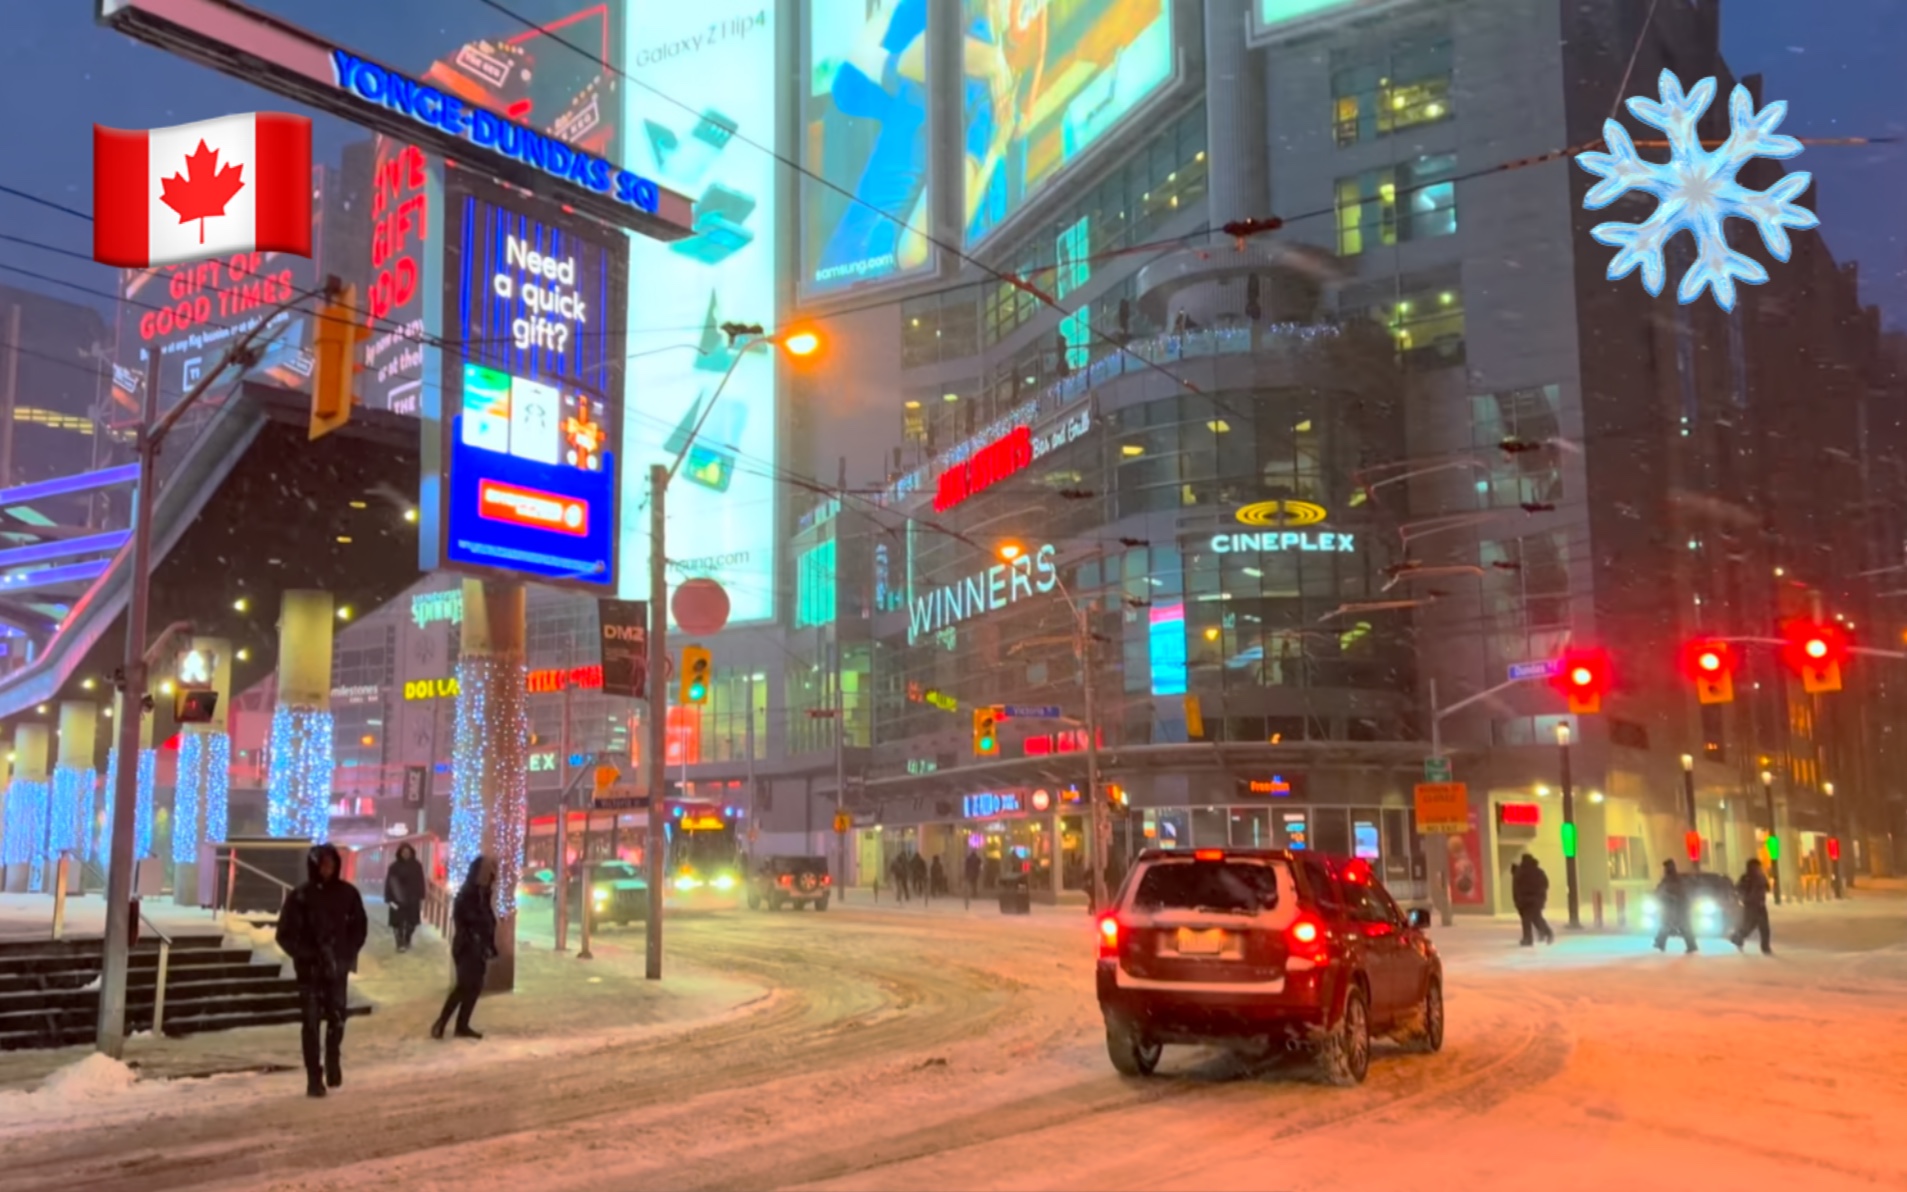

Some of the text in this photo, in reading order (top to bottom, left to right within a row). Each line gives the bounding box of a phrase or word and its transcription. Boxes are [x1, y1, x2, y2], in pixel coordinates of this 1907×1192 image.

[636, 34, 702, 67] Galaxy
[707, 24, 717, 45] Z
[331, 49, 611, 194] YONGE-DUNDAS
[169, 252, 262, 300] GIFT OF
[507, 234, 575, 286] Need
[815, 253, 894, 281] samsung.com
[140, 269, 293, 340] GOOD TIMES
[494, 273, 586, 322] a quick
[512, 315, 568, 353] gift?
[1211, 531, 1355, 554] CINEPLEX
[907, 543, 1056, 642] WINNERS
[603, 624, 646, 643] DMZ
